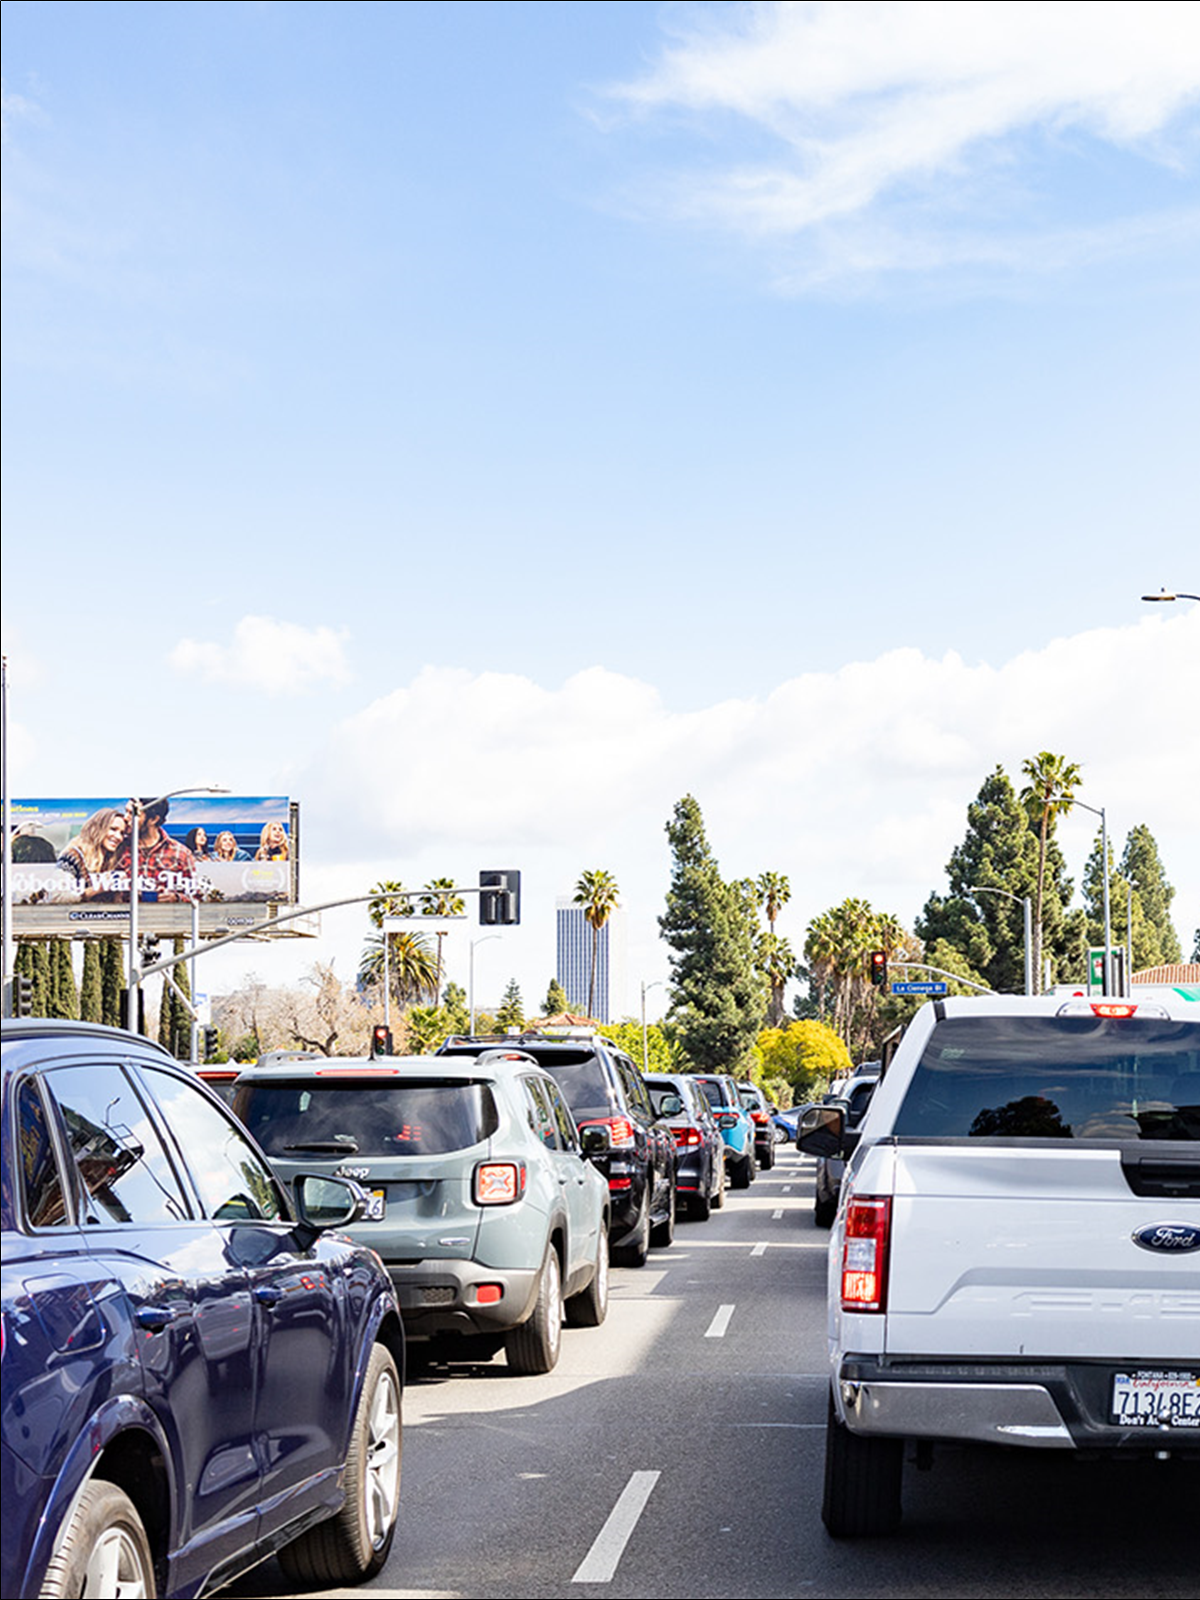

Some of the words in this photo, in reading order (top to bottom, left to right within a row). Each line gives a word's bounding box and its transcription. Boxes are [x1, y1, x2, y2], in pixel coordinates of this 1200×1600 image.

[12, 872, 85, 896] obody
[335, 1166, 371, 1179] Jeep
[1151, 1227, 1196, 1246] Ford
